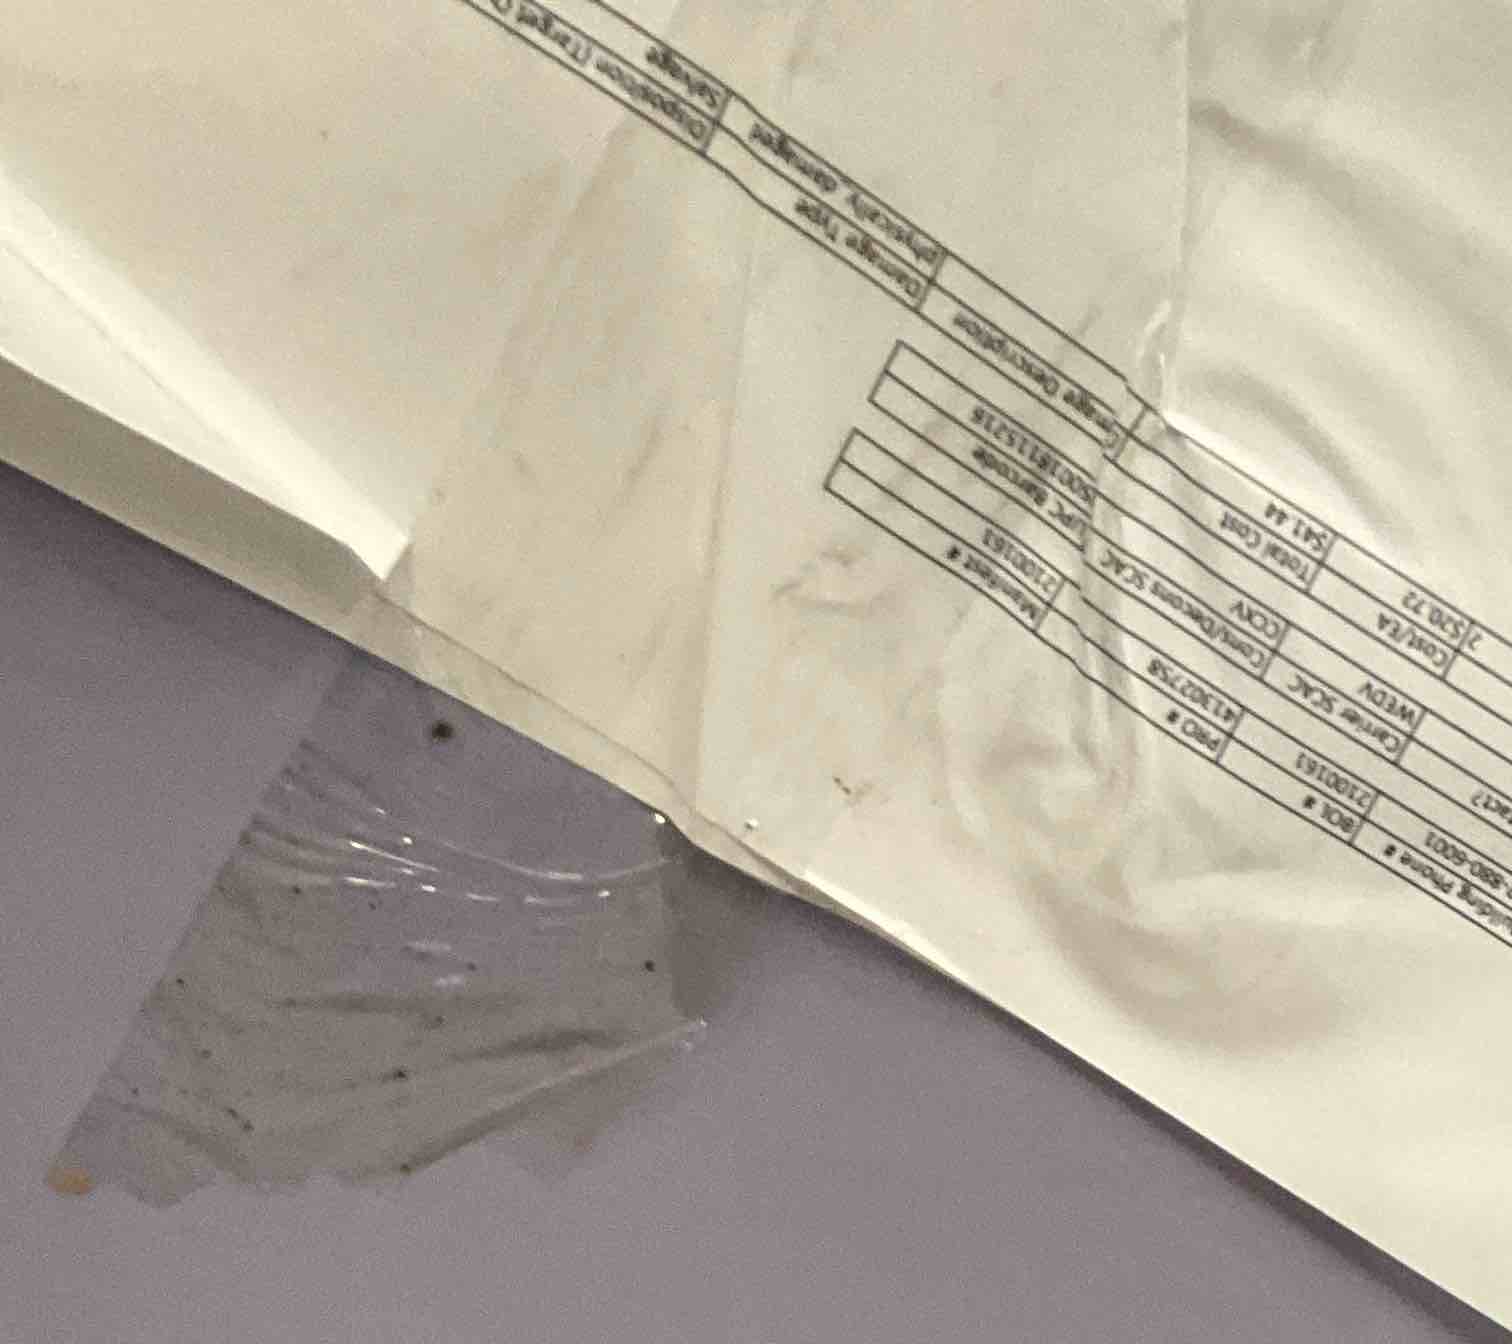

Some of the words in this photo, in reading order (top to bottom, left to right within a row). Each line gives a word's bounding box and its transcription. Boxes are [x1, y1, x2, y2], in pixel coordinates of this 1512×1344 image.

[597, 57, 705, 139] Disposition
[644, 46, 720, 107] Salvage
[788, 194, 846, 243] Type
[836, 228, 929, 300] Damage
[946, 309, 1065, 397] Description
[966, 443, 1051, 507] Barcode
[1216, 511, 1264, 550] Cost
[1261, 499, 1328, 550] $41.44
[1097, 549, 1150, 591] SCAC
[1259, 539, 1313, 582] Total
[957, 554, 1045, 621] Manifest
[1398, 587, 1466, 640] $20.72
[1372, 608, 1452, 669] Cost/EA
[1285, 672, 1339, 716] SCAC
[1355, 677, 1418, 726] WEDV
[1179, 716, 1223, 752] PRO
[1337, 705, 1401, 754] Carrier
[1317, 802, 1356, 835] BOL
[1396, 849, 1456, 896] Phone
